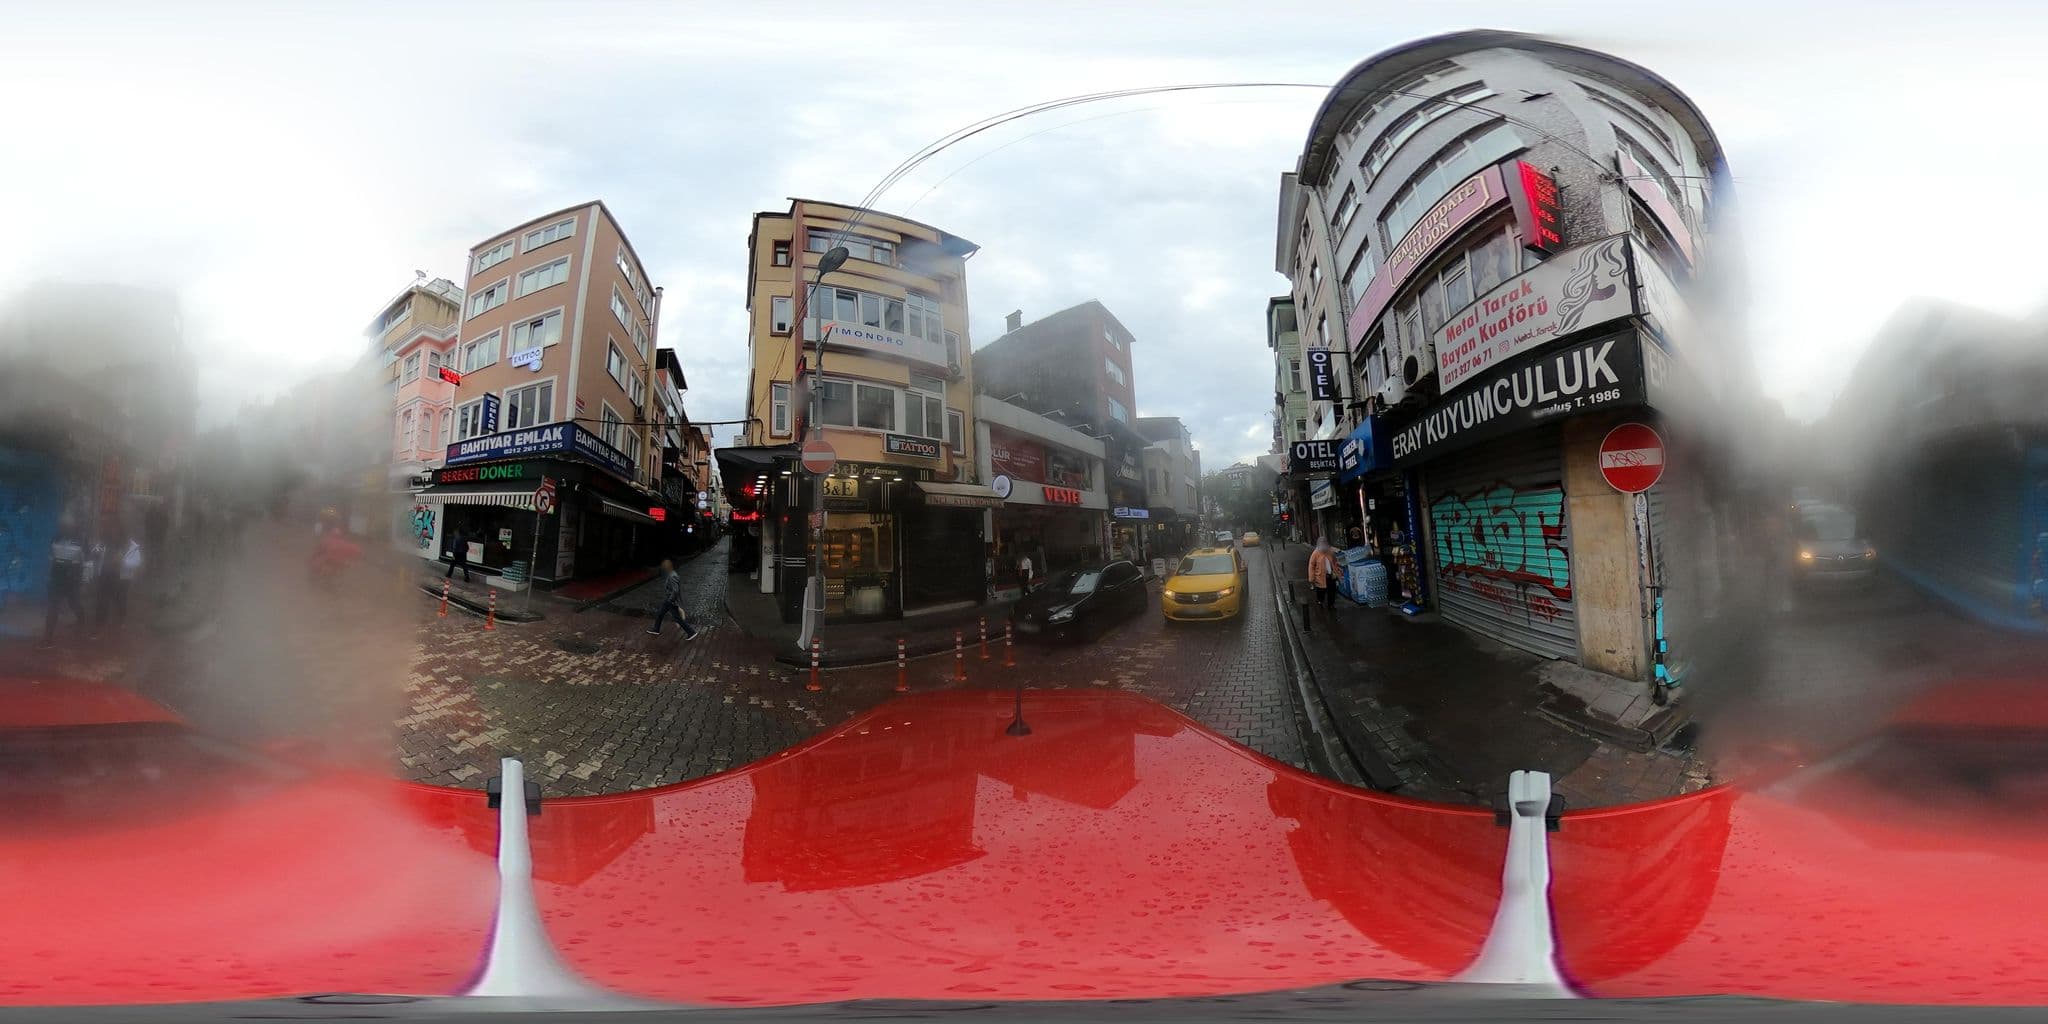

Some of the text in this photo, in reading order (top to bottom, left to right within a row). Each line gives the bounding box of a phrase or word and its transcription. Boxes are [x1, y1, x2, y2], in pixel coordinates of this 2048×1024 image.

[1391, 228, 1424, 269] BEAUTY
[1426, 182, 1477, 231] UPDATE
[1408, 216, 1450, 265] SALOON
[1446, 279, 1533, 345] Metal Tarak
[1441, 295, 1548, 369] Bayan Kuaförü
[1312, 352, 1330, 398] OTEL
[1444, 347, 1492, 386] 0212 327 06 71
[487, 400, 498, 431] EMLAK
[1392, 340, 1620, 460] ERAY KUYUMCULUK
[1574, 396, 1585, 408] T.
[1589, 388, 1621, 404] 1986
[460, 426, 563, 455] BAHTİYAR EMLAK
[901, 442, 936, 454] TATTOO
[1296, 442, 1336, 460] OTEL
[441, 468, 480, 482] BEREKET
